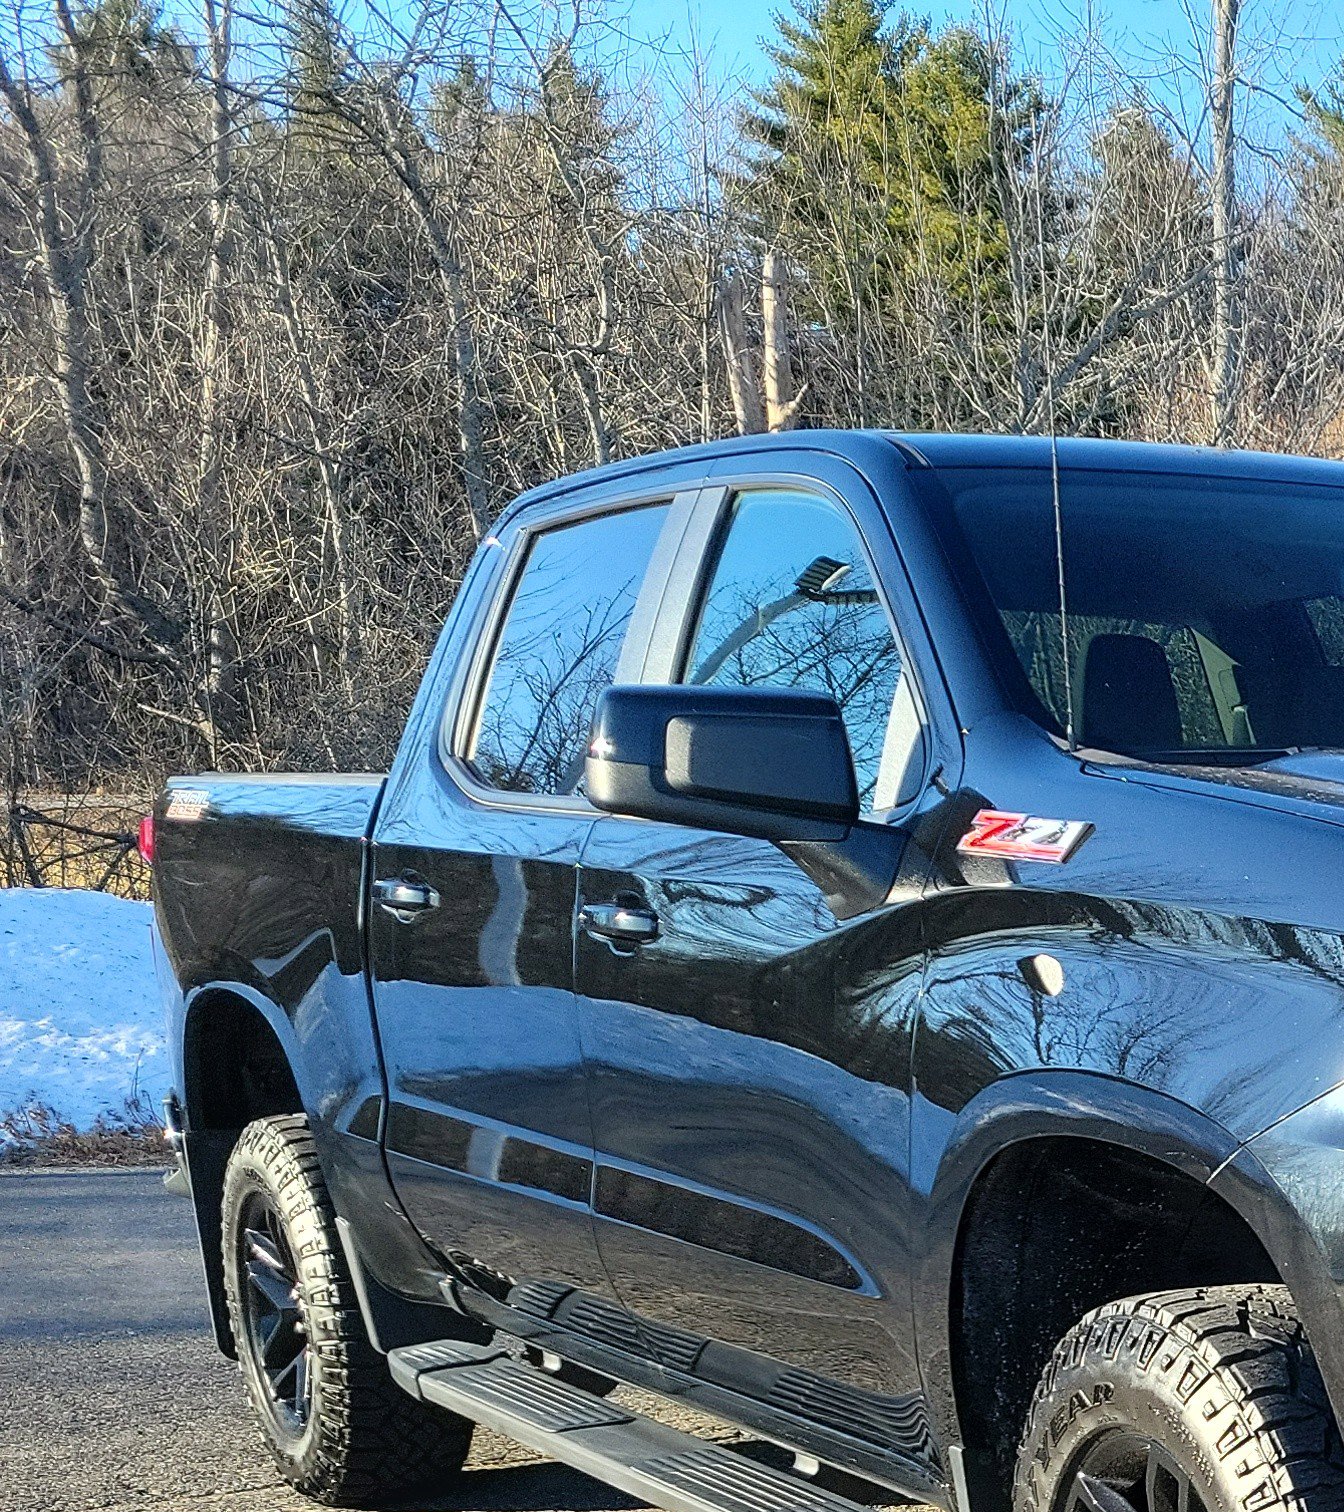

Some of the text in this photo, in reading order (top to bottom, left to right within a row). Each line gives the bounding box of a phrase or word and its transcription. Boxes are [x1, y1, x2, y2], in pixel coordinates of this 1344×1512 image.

[171, 789, 210, 806] TRAIL
[166, 805, 202, 819] BOSS
[956, 809, 1096, 864] Z71
